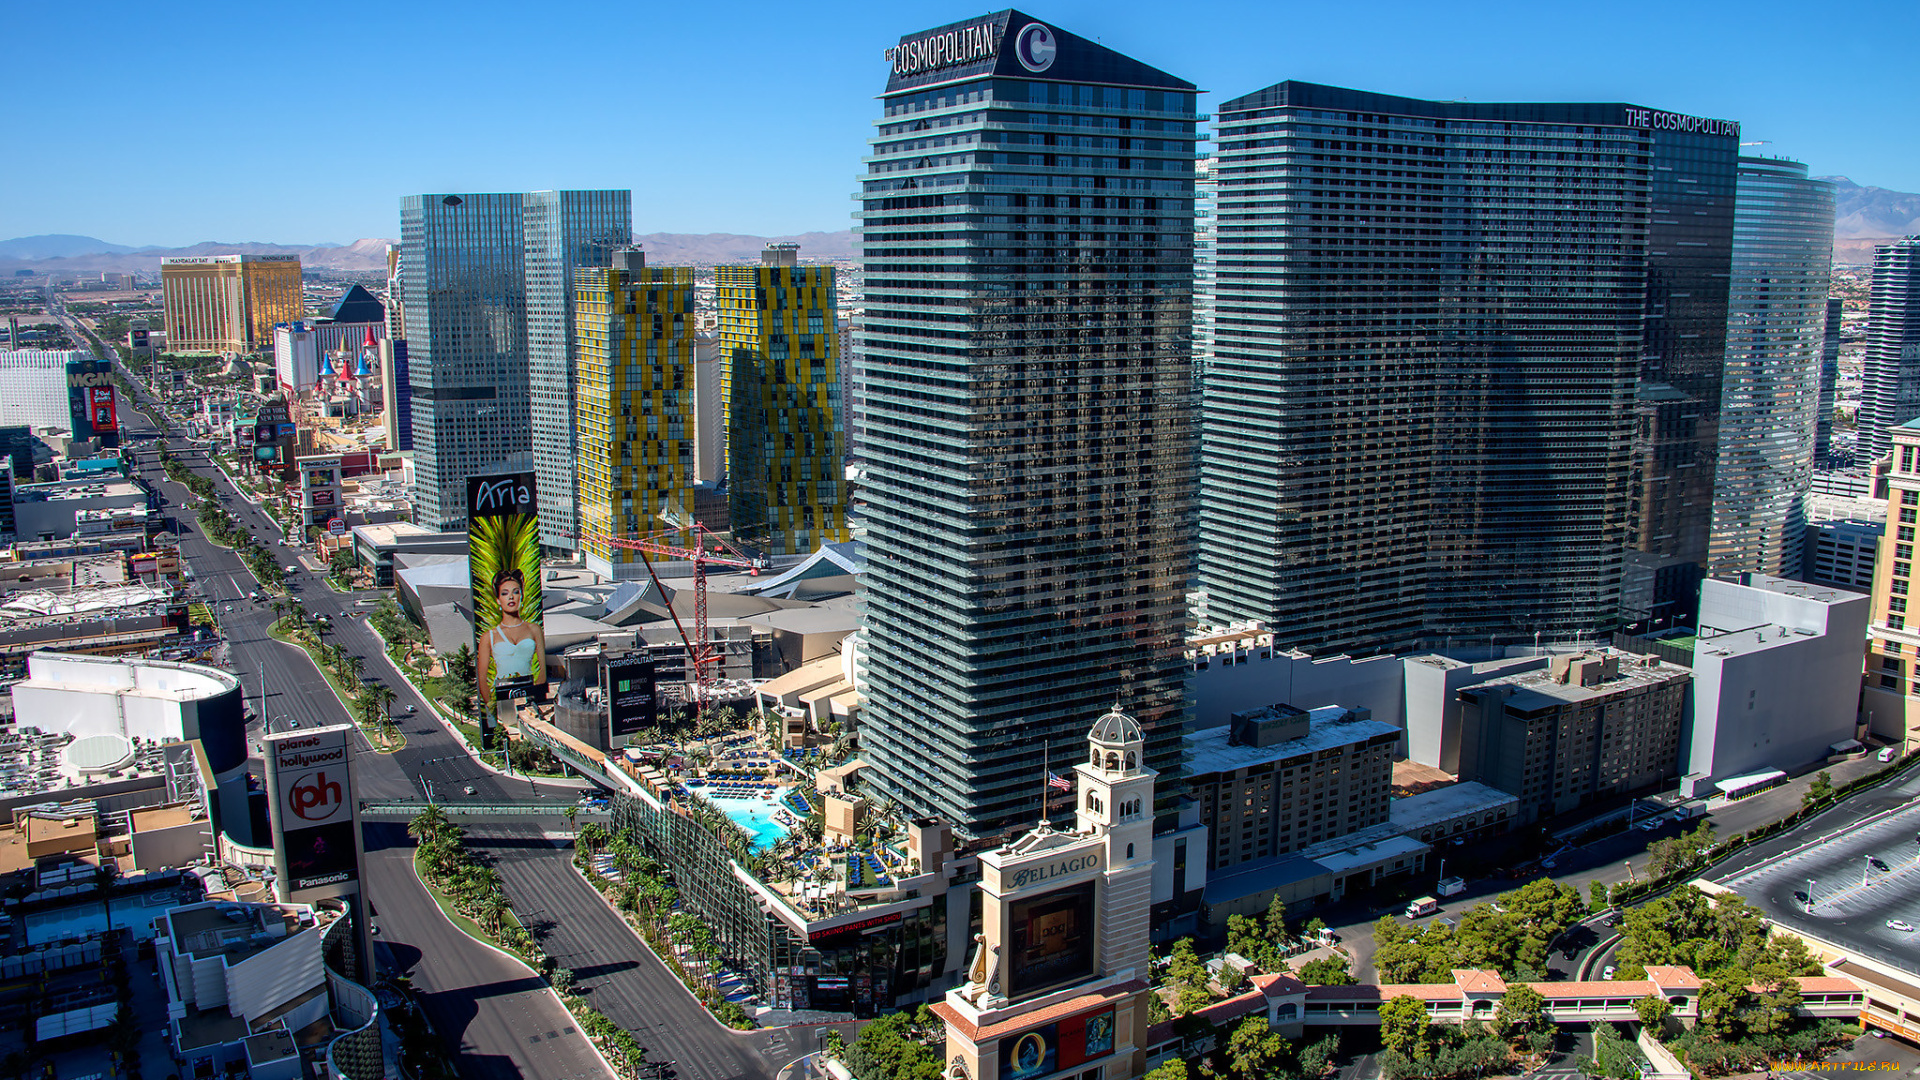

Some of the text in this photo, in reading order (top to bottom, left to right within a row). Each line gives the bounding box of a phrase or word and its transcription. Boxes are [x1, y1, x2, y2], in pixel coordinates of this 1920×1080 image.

[884, 22, 994, 74] THE COSMOPOLITAN
[1625, 108, 1740, 136] THE COSMOPOLITAN
[67, 371, 114, 388] MGM
[476, 479, 530, 511] Aria
[609, 653, 654, 668] COSMOPOLITAN
[508, 688, 527, 700] Aria
[278, 735, 320, 754] planet
[280, 748, 343, 767] hollywood
[294, 771, 342, 819] ph
[299, 872, 349, 888] Panasonic
[1006, 854, 1098, 889] BELLAGIO
[821, 927, 844, 938] SKIING
[844, 921, 866, 932] PANTS
[866, 917, 883, 927] WITH
